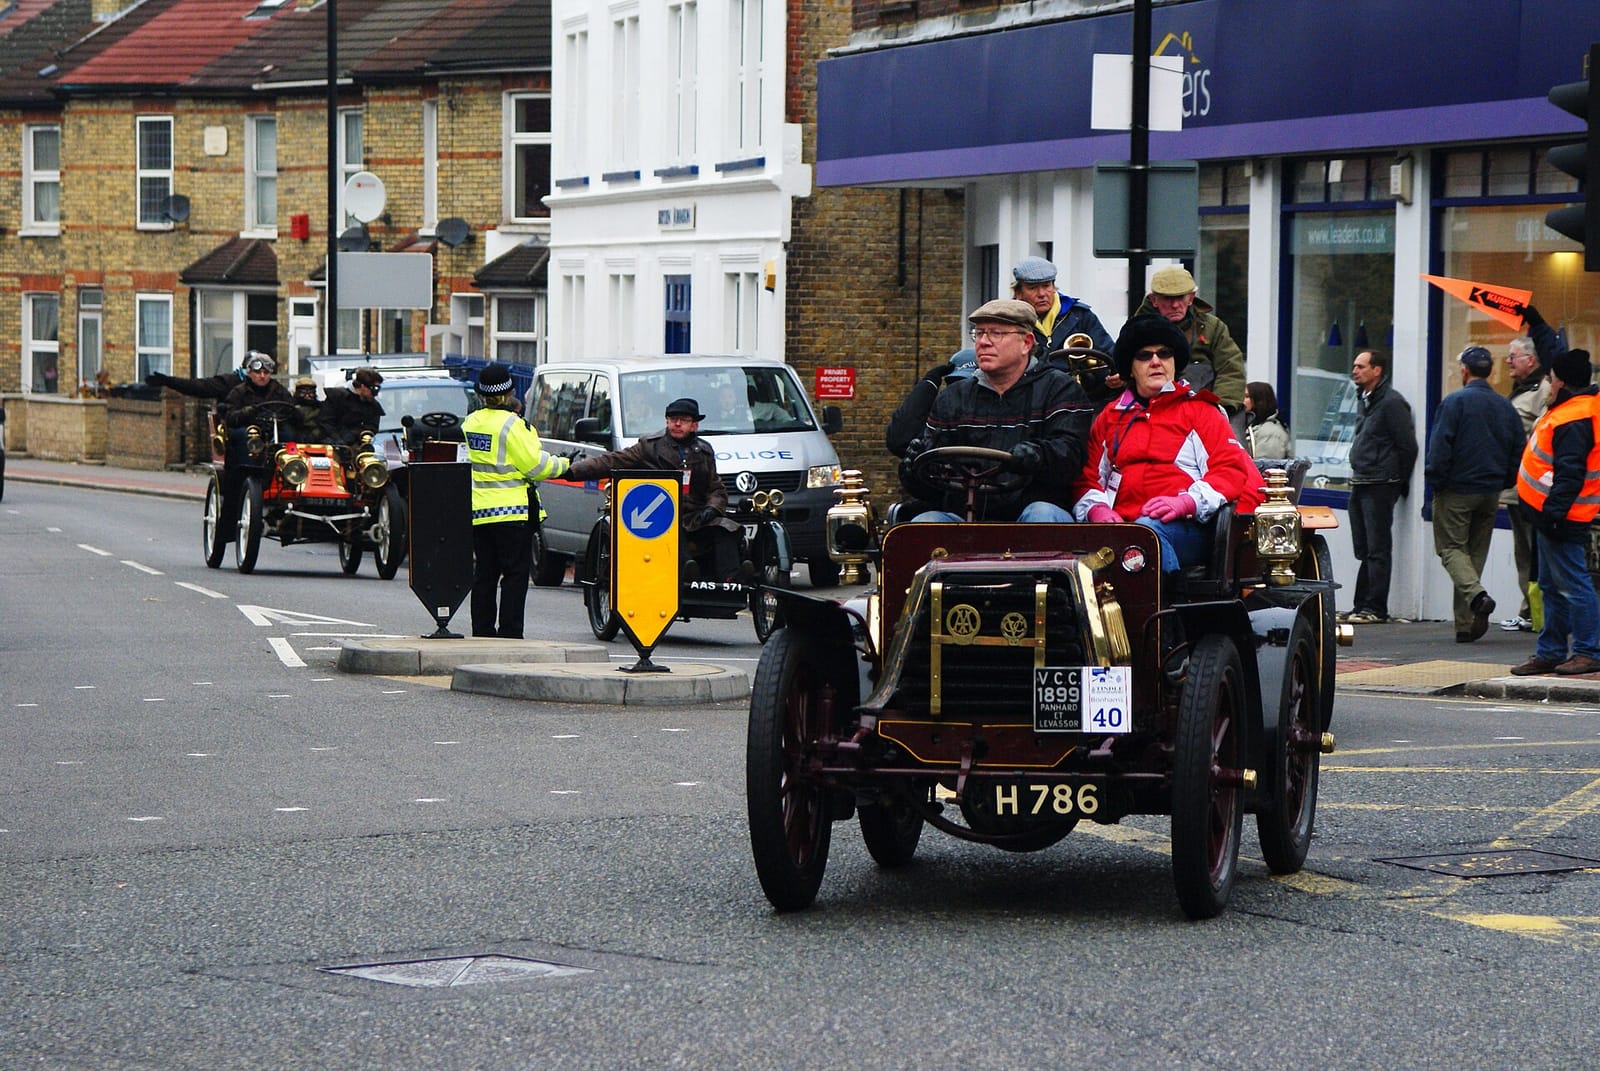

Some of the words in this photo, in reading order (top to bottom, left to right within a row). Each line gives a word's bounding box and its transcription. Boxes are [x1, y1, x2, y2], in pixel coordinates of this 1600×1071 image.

[1181, 69, 1211, 118] ers
[1308, 224, 1386, 244] www.leaders.co.uk
[469, 438, 491, 451] OLICE
[714, 450, 794, 461] OLICE
[690, 581, 717, 591] AAS
[723, 582, 742, 592] 571
[1037, 686, 1080, 703] 1899
[1040, 703, 1079, 712] PANHARD
[1039, 719, 1079, 728] LEVASSOR
[1093, 708, 1122, 727] 40
[995, 784, 1018, 815] H
[1029, 783, 1099, 815] 786
